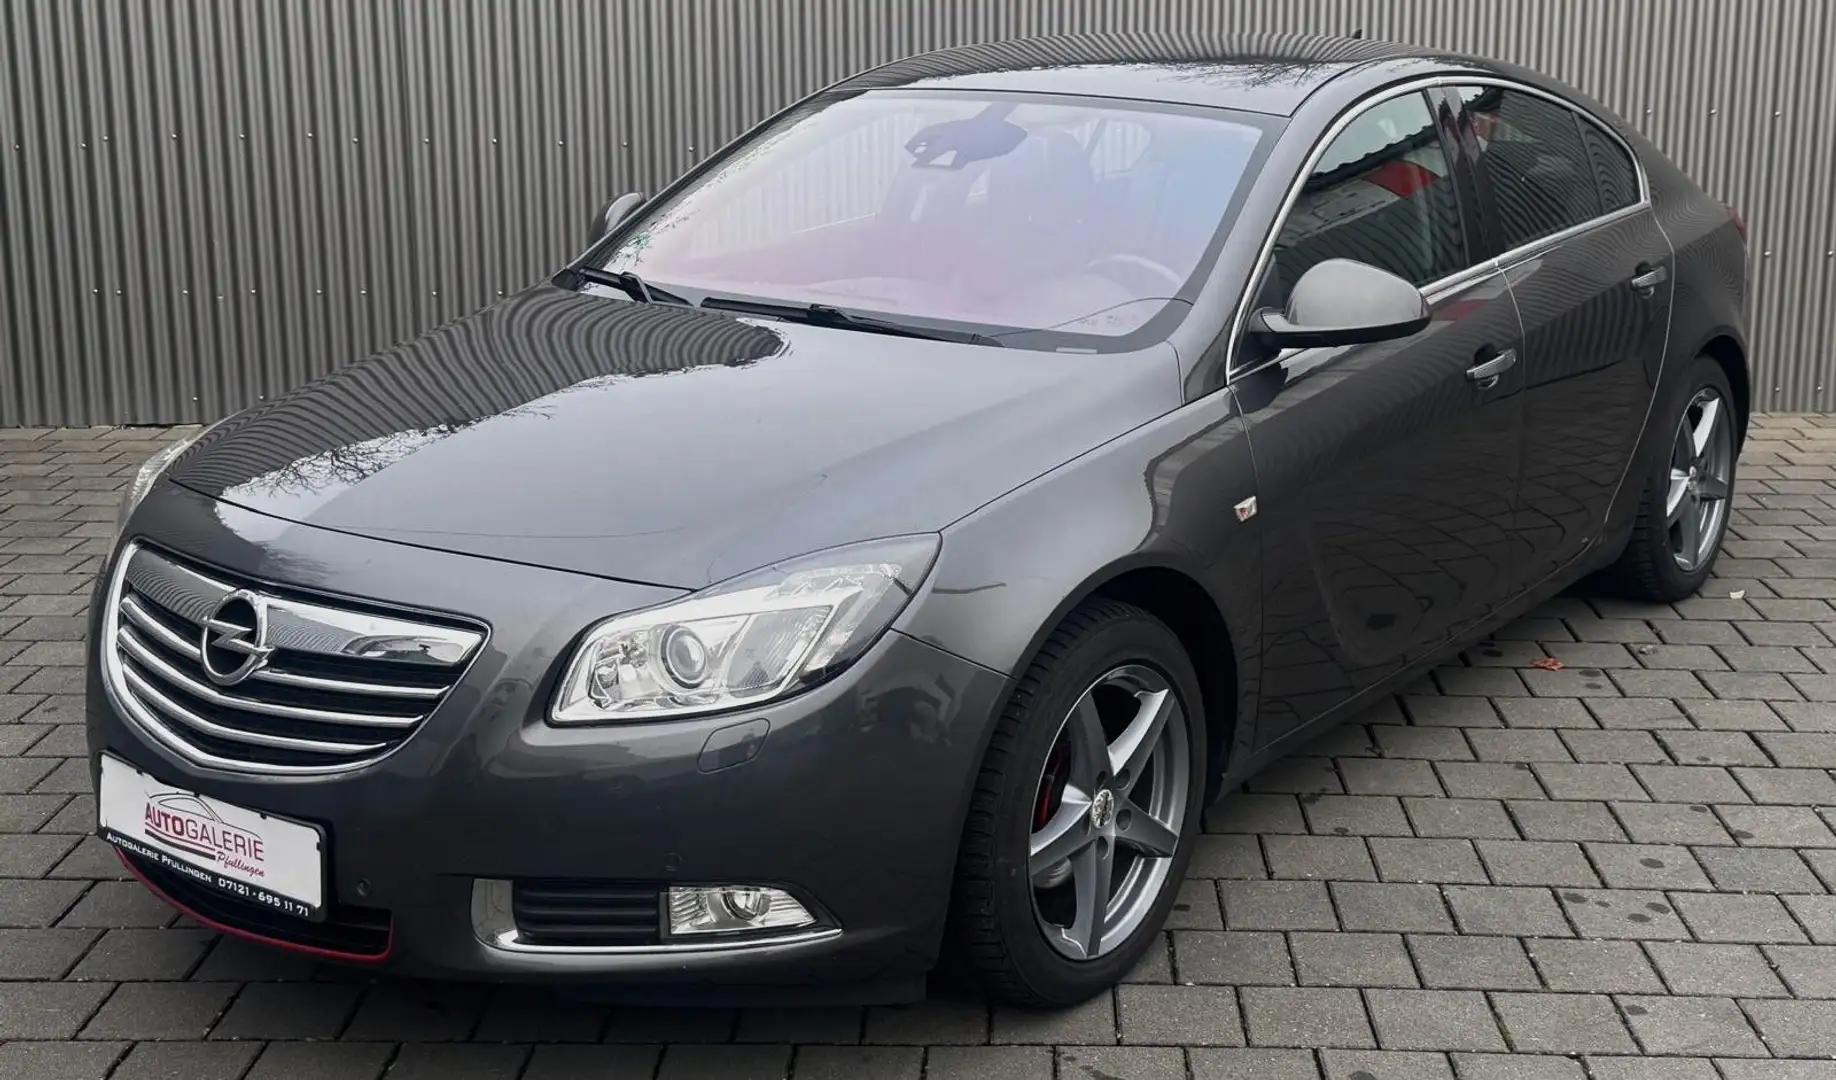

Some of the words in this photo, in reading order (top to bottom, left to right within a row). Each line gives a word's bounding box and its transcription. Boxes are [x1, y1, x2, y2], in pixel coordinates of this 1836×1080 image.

[145, 802, 264, 861] AUTOGALERIE
[216, 851, 265, 877] Pfullingen
[218, 878, 249, 896] 07121
[258, 891, 281, 907] 695
[284, 900, 293, 911] 11
[296, 905, 309, 917] 71
